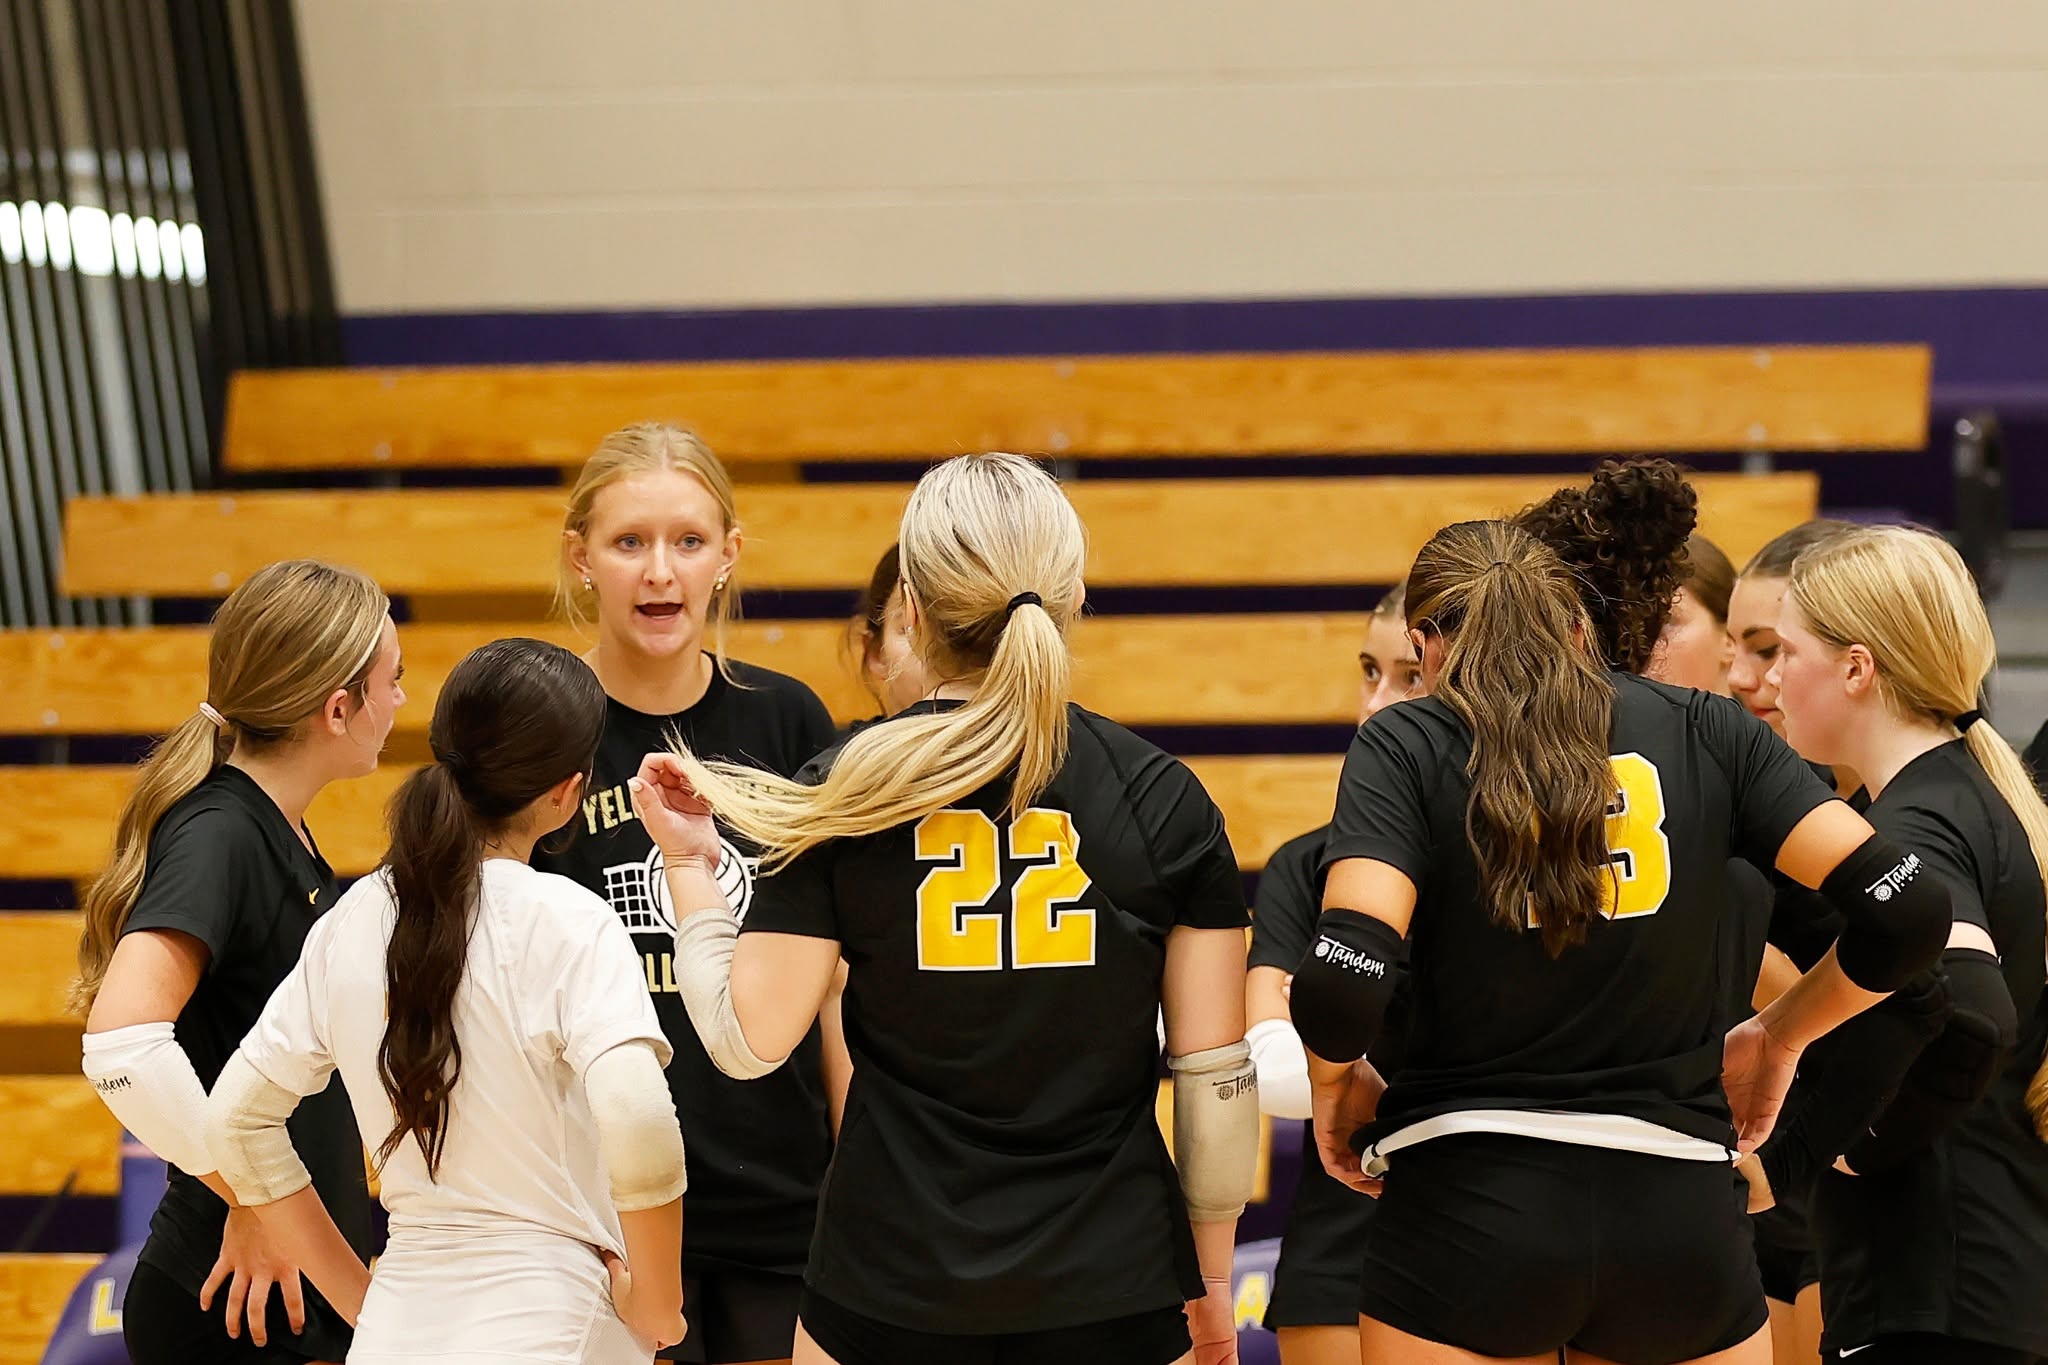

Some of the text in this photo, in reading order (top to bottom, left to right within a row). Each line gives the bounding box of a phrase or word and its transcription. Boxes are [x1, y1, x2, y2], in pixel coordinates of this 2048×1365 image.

[582, 784, 640, 836] YEL
[914, 807, 1097, 971] 22
[1319, 933, 1385, 976] Tandem
